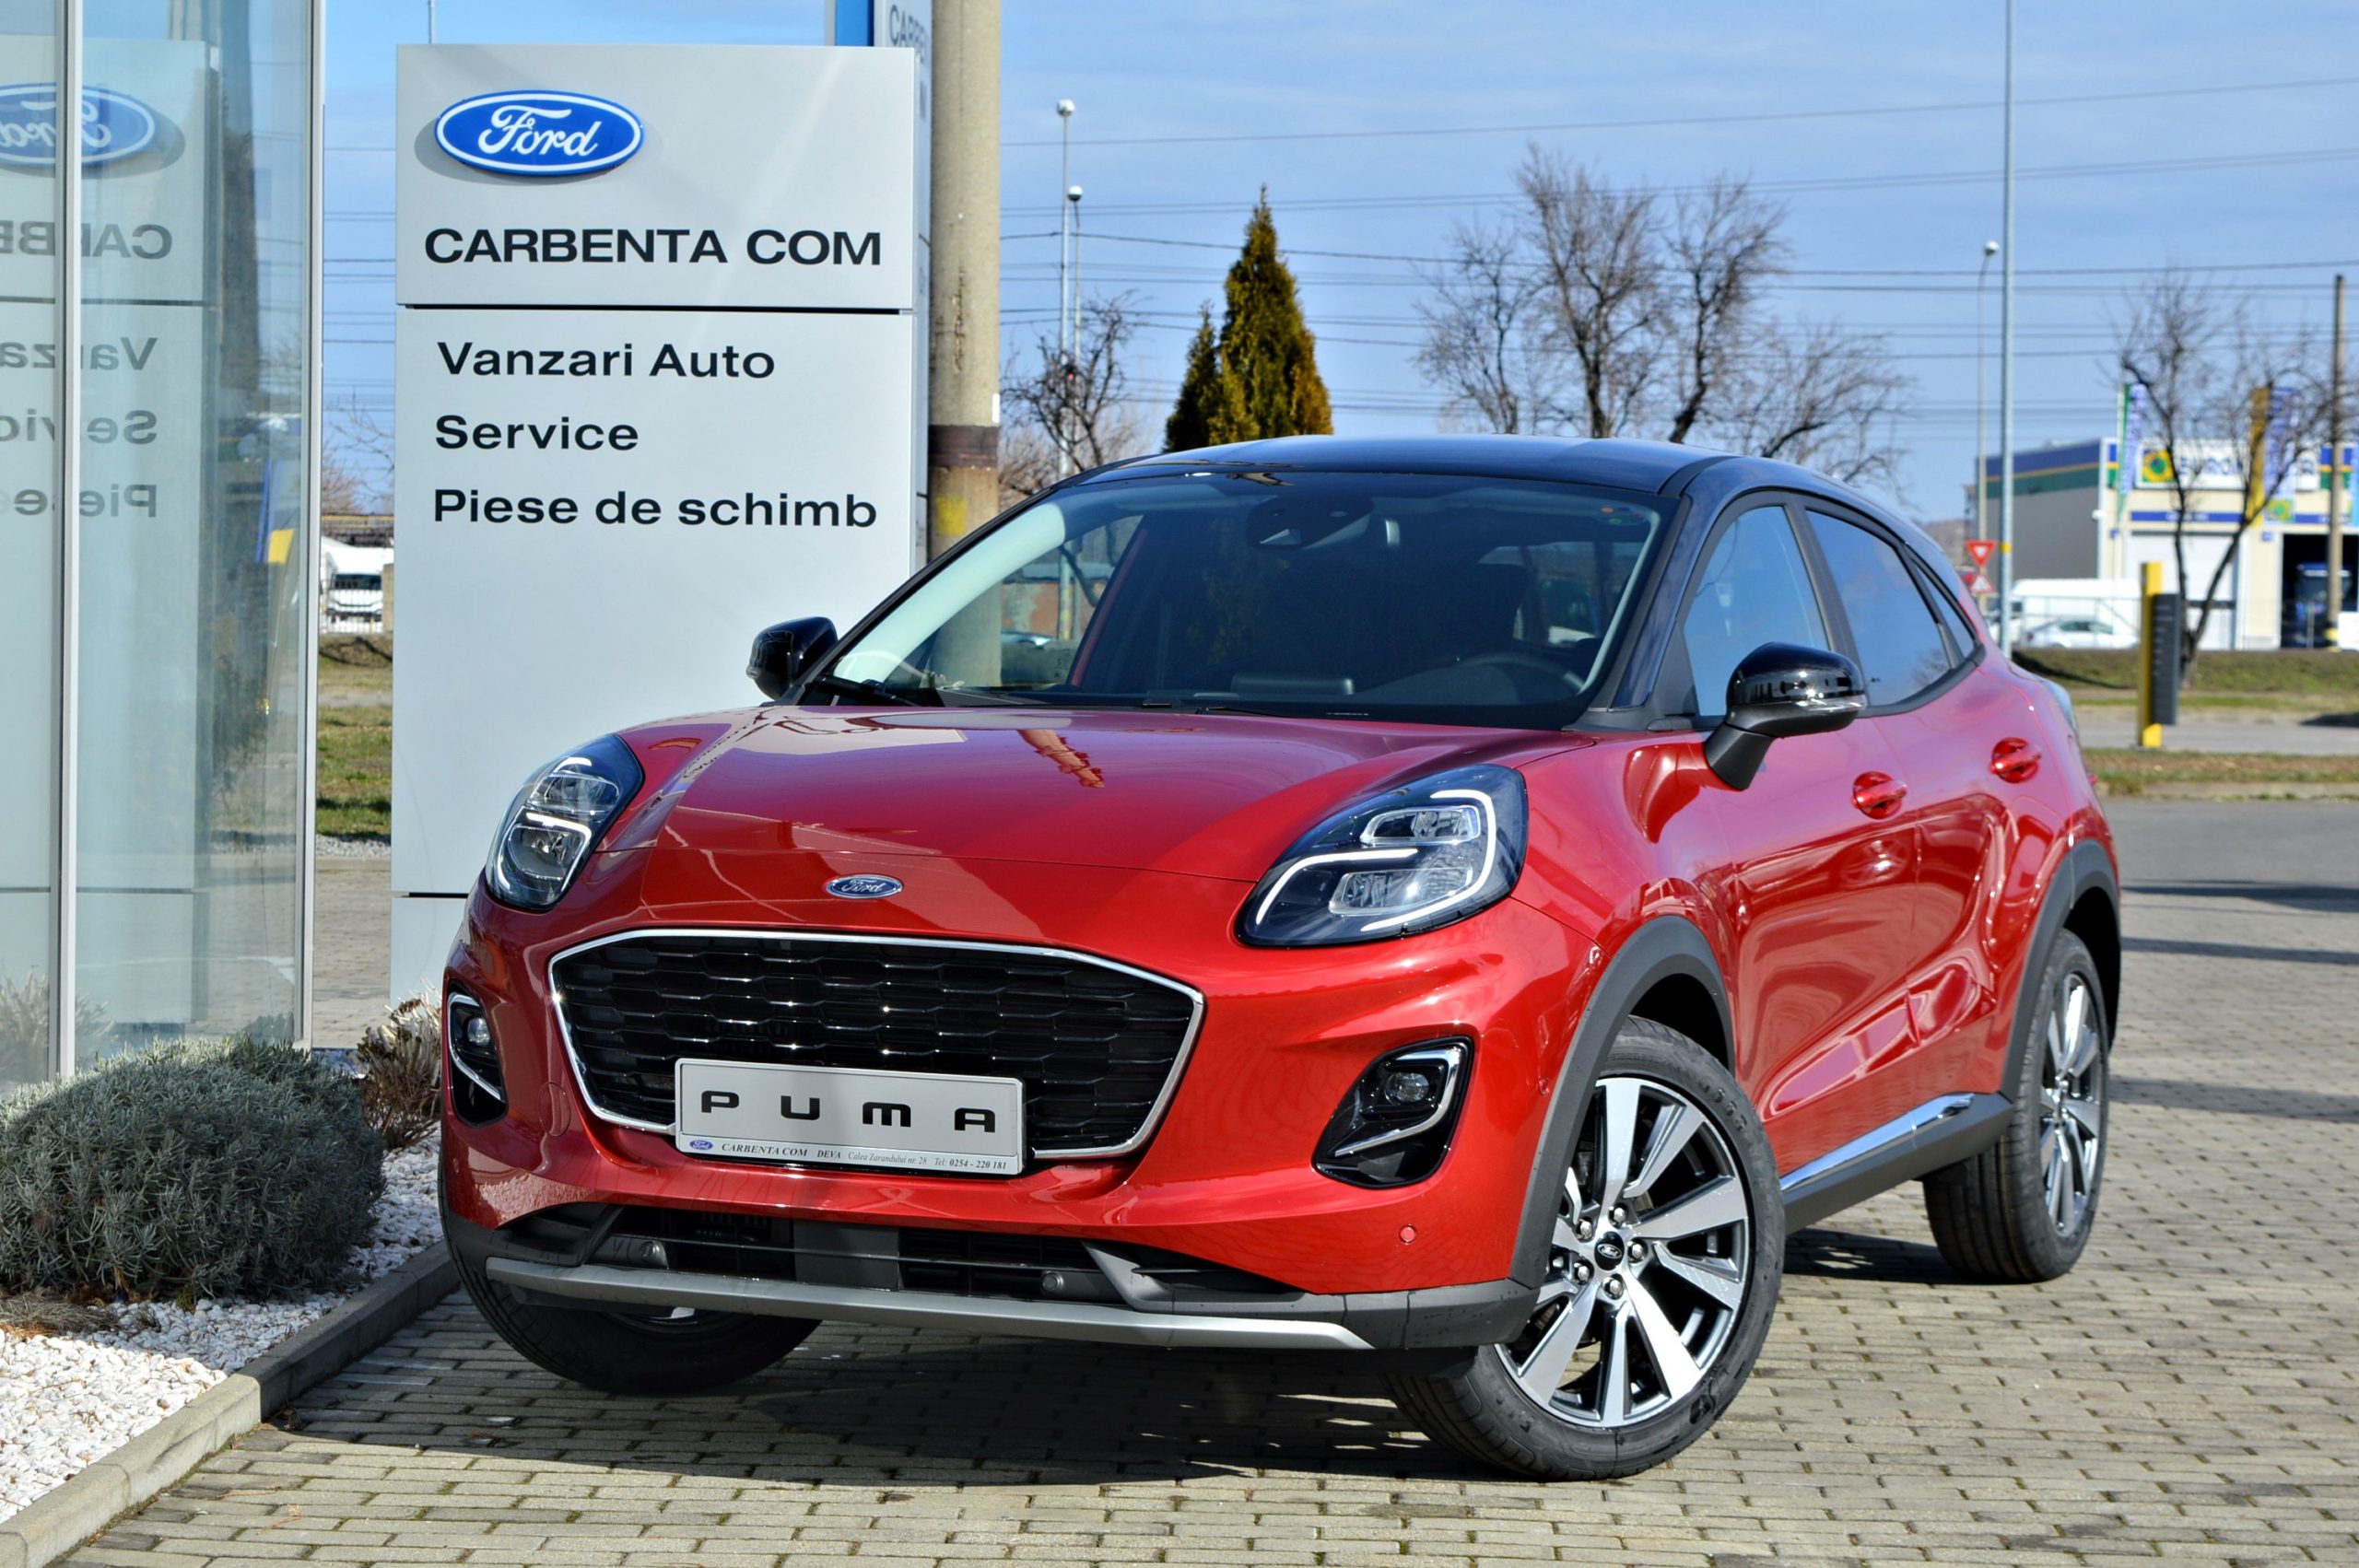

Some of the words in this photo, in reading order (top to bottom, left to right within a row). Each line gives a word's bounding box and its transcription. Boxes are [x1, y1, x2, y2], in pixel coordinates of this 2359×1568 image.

[478, 105, 601, 156] Ford
[425, 228, 728, 264] CARBENTA
[746, 228, 881, 265] COM
[437, 341, 632, 377] Vanzari
[649, 344, 775, 379] Auto
[435, 415, 639, 451] Service
[434, 488, 579, 524] Piese
[595, 490, 662, 525] de
[677, 492, 877, 528] schimb
[701, 1090, 996, 1133] PUMA
[722, 1142, 780, 1155] CARBENTA
[781, 1147, 808, 1157] COM
[816, 1149, 841, 1159] DEVA
[949, 1158, 968, 1167] 0254
[976, 1160, 991, 1169] 220
[992, 1161, 1007, 1170] 181
